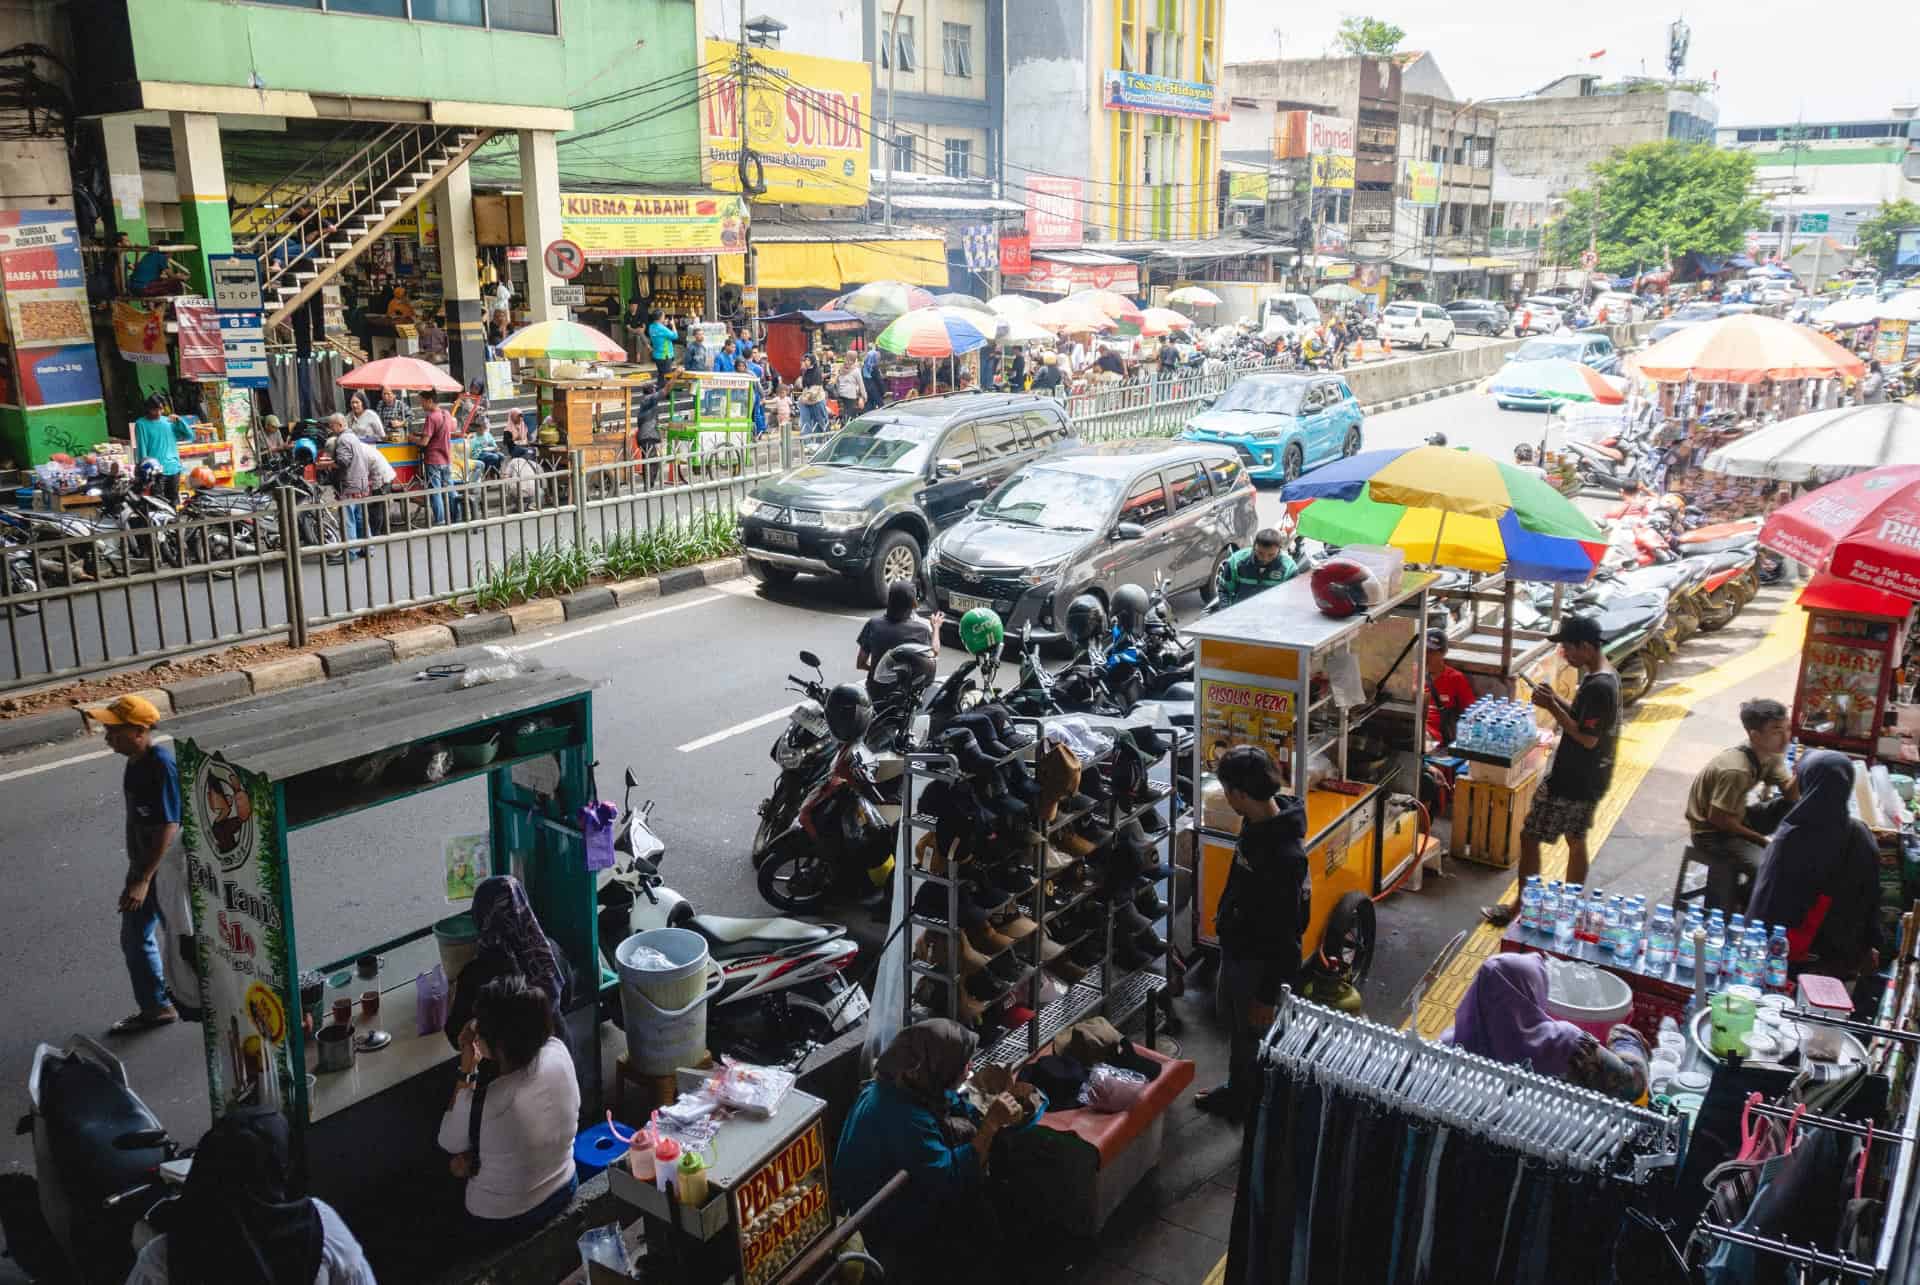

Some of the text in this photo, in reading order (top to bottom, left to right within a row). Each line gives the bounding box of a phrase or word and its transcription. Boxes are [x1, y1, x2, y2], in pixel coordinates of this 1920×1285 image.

[1127, 77, 1153, 91] Toko
[785, 86, 862, 148] SUNDA
[1313, 121, 1353, 150] Rinnai
[568, 198, 689, 217] KURMA ALBANI
[6, 271, 39, 281] HARGA
[218, 291, 258, 300] STOP
[1207, 685, 1251, 707] RISOLIS
[735, 1127, 823, 1232] PENTOL
[743, 1184, 826, 1273] PENTOL
